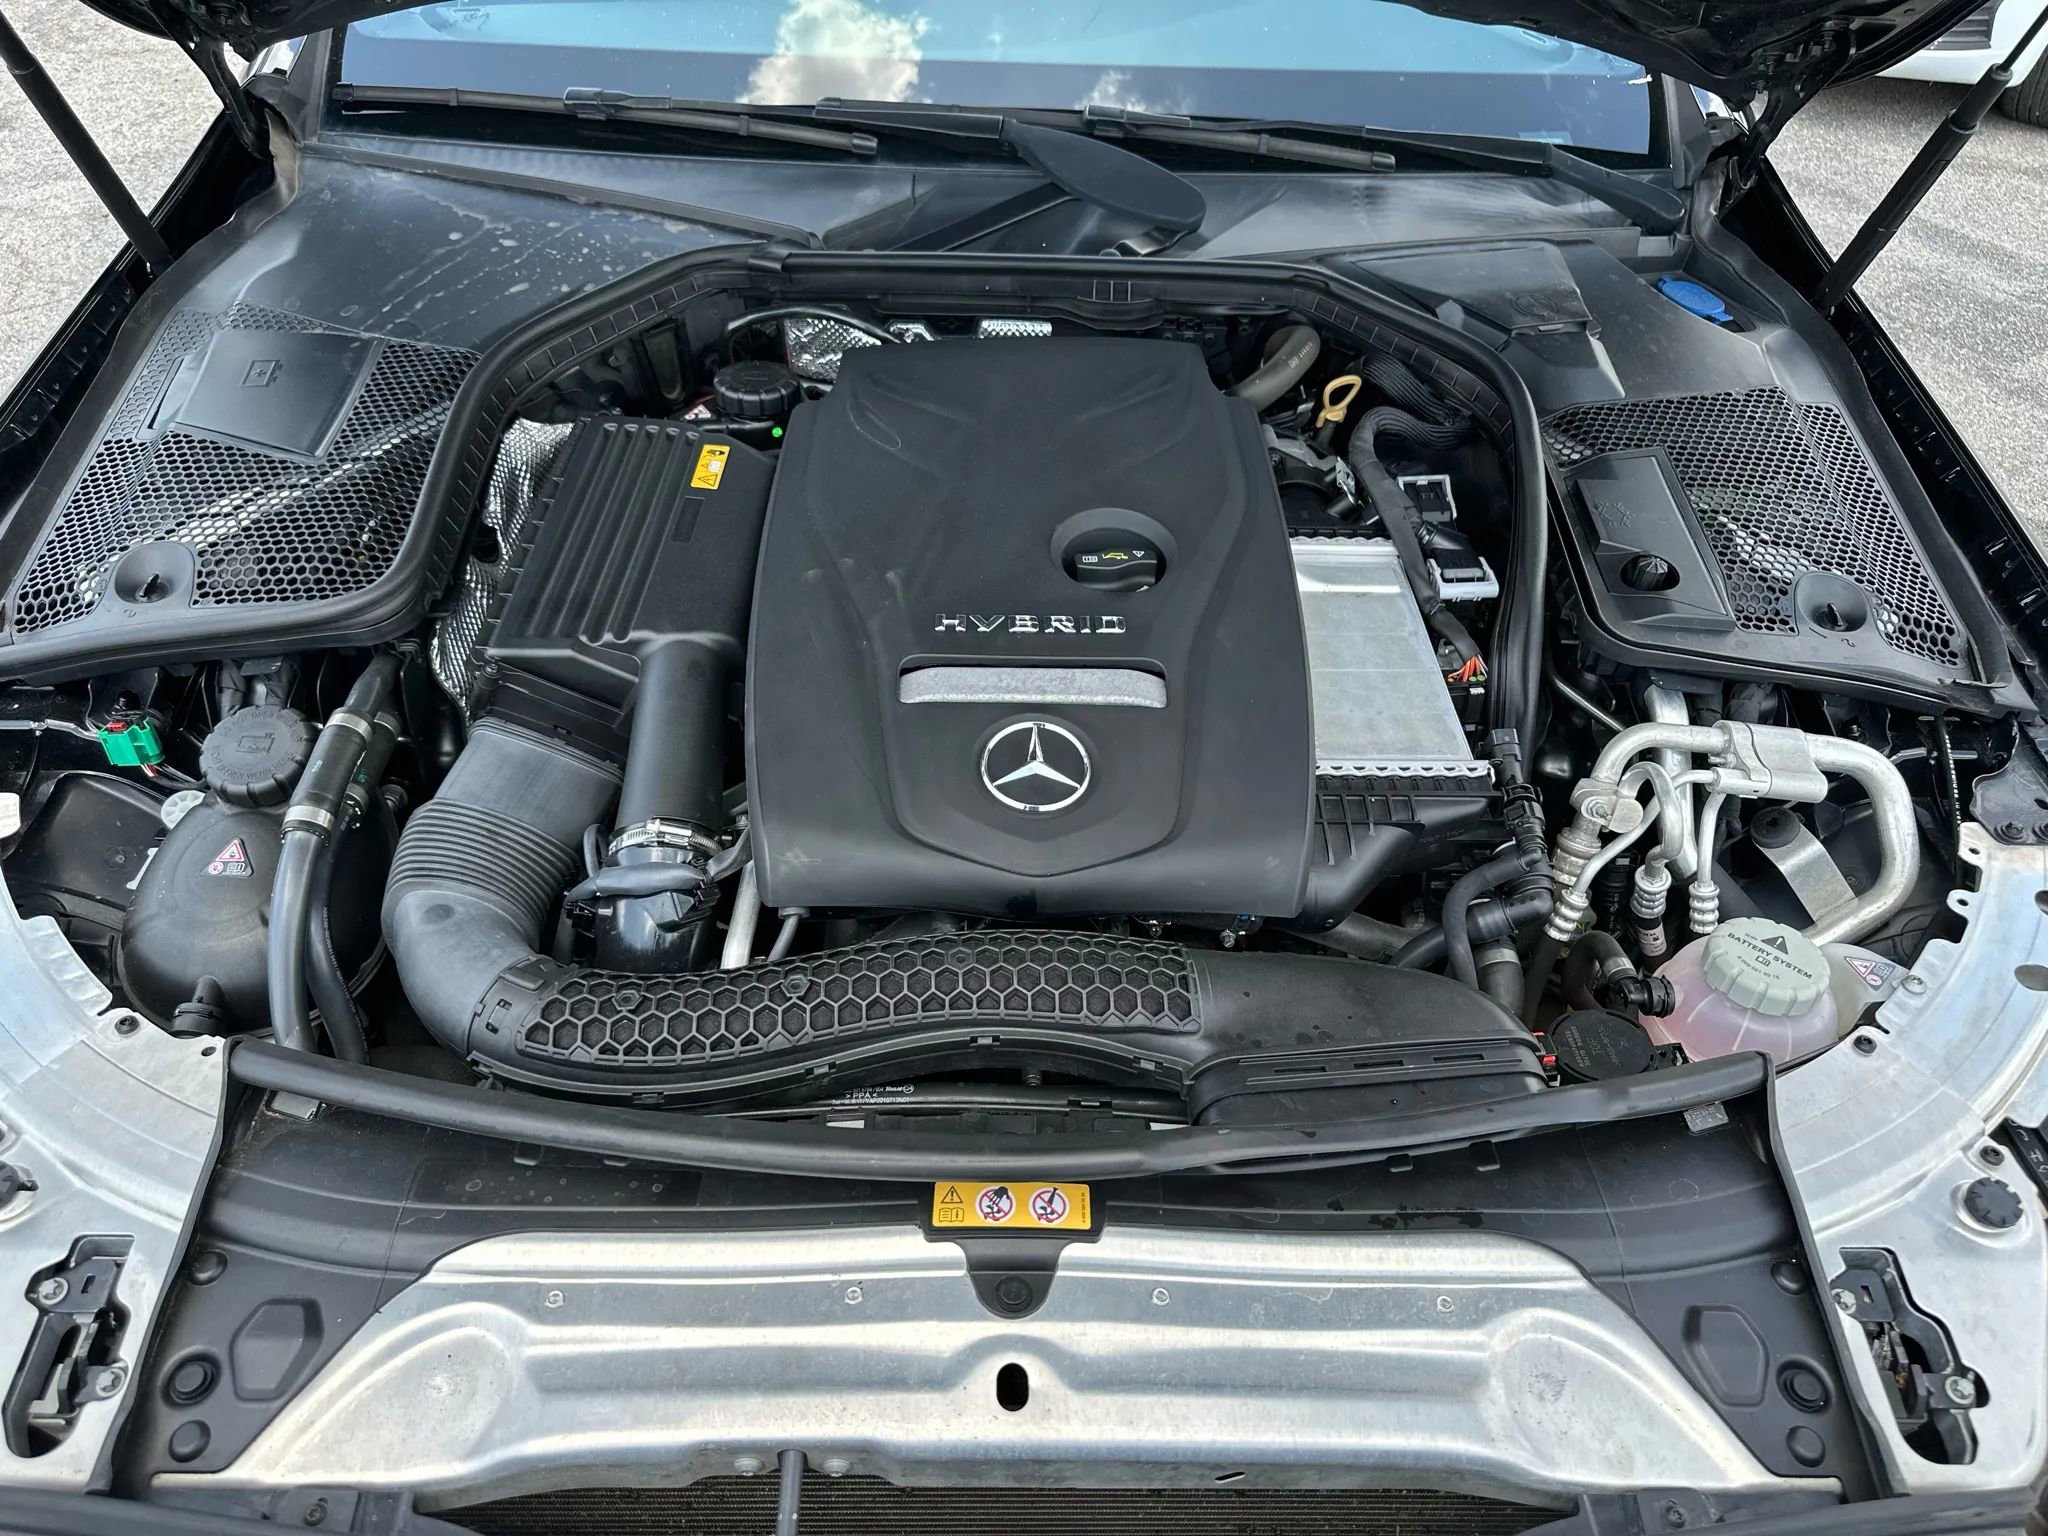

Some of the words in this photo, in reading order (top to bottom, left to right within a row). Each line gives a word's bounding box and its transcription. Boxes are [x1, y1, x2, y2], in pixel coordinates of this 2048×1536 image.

[934, 613, 1127, 634] HYBRID
[1727, 932, 1772, 957] BATTERY
[1772, 955, 1813, 979] SYSTEM
